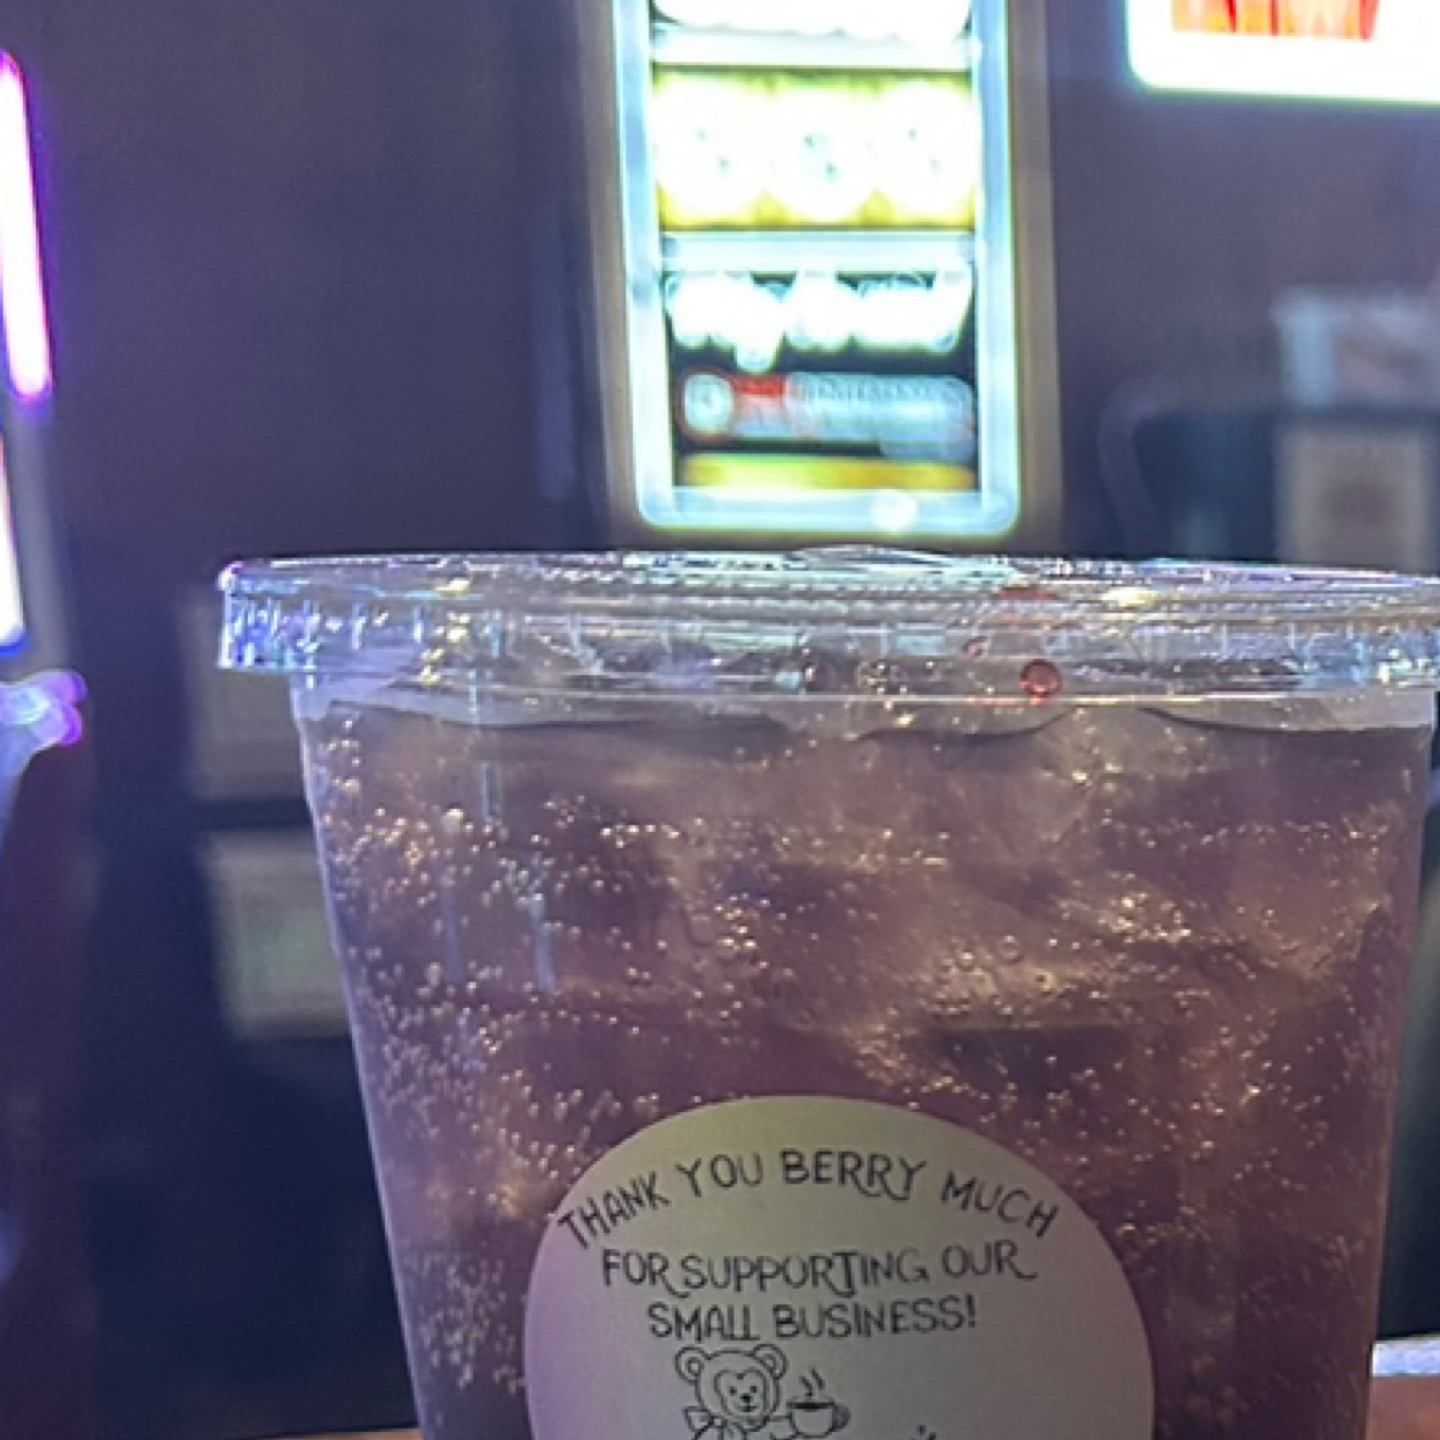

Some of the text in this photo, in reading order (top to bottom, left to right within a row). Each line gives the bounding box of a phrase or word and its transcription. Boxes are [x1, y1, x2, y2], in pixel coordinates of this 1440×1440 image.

[557, 1149, 1061, 1249] THANK YOU BERRY MUCH
[602, 1241, 1038, 1299] FOR SUPPORTING OUR
[648, 1295, 978, 1341] SMALL BUSINESS!
